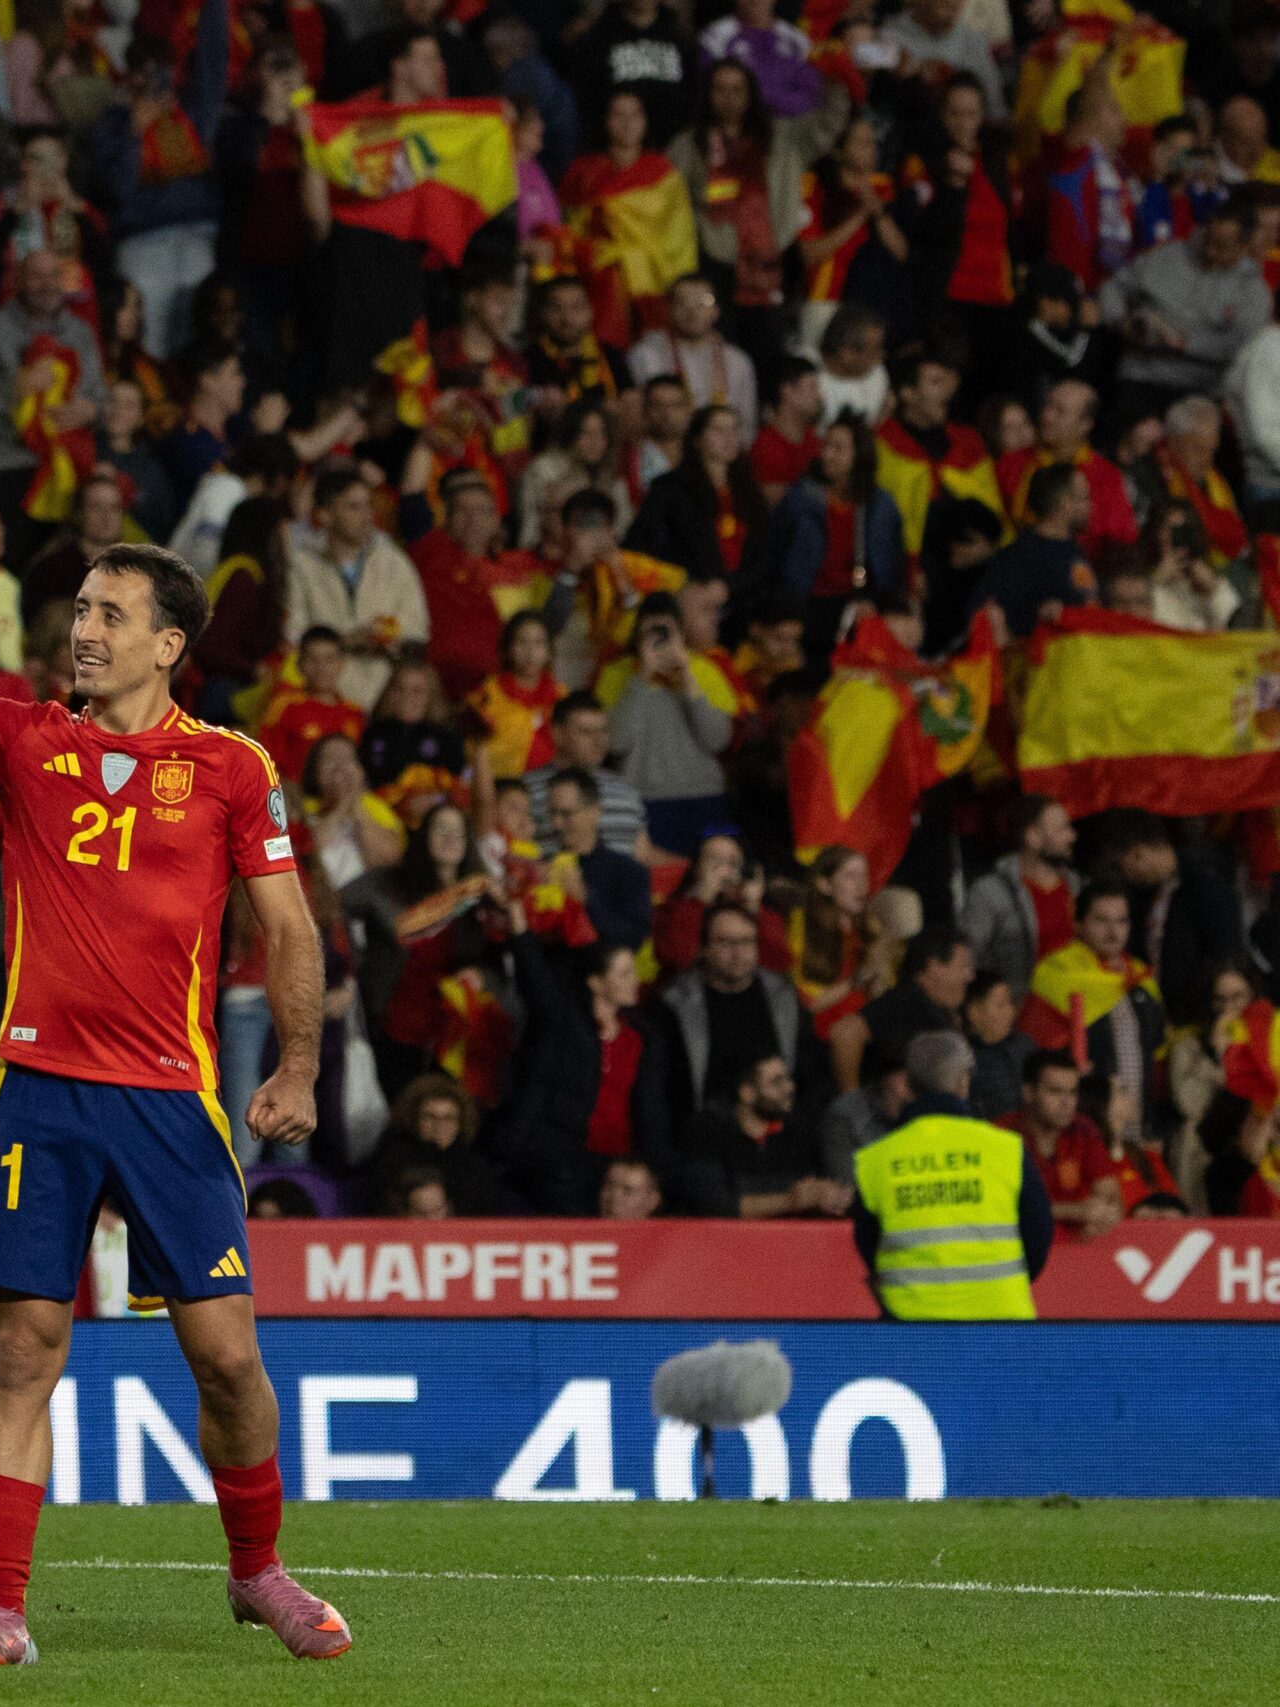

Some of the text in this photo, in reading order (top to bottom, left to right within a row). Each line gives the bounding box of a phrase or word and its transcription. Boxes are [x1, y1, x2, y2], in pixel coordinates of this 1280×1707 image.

[66, 802, 137, 871] 21
[891, 1151, 981, 1175] EULEN
[305, 1243, 618, 1302] MAPFRE
